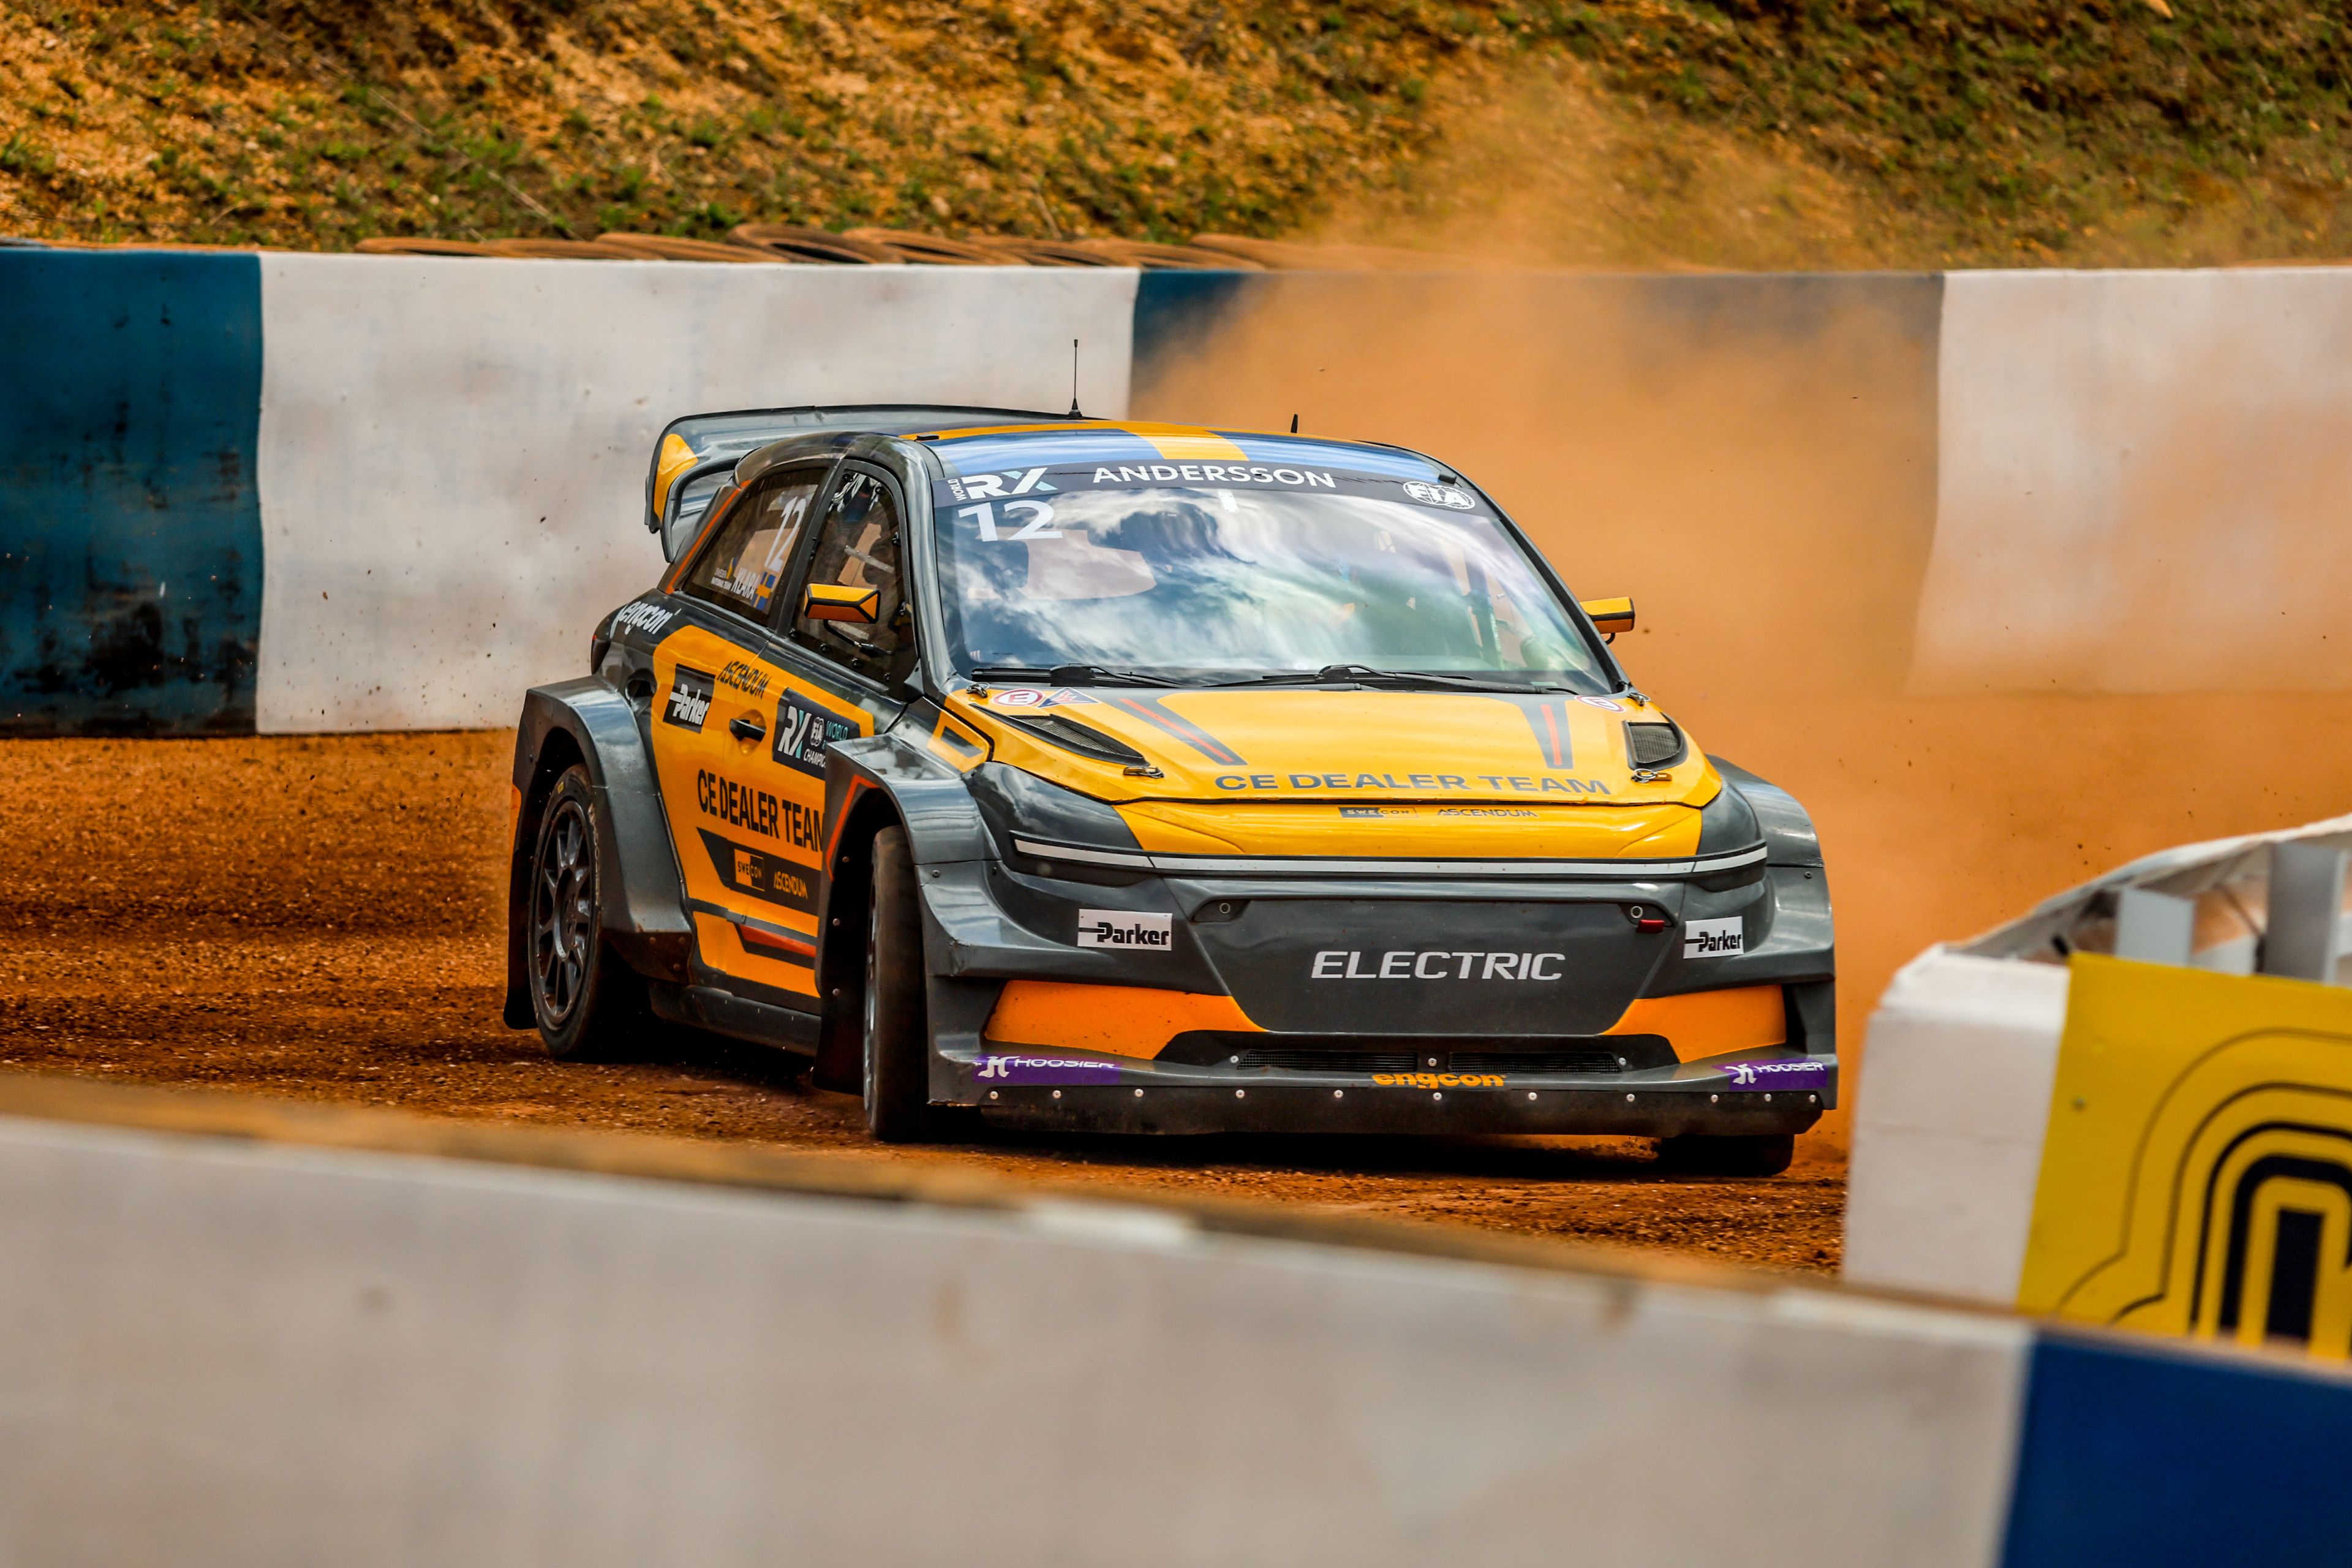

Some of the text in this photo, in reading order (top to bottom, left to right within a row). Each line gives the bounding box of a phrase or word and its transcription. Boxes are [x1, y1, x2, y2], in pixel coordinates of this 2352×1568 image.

[961, 467, 1058, 500] RX
[1093, 466, 1336, 488] ANDERSSON
[948, 479, 967, 501] WORLD
[1407, 484, 1471, 506] FIA
[958, 500, 1063, 542] 12
[764, 496, 807, 573] 12
[619, 601, 673, 635] engcon
[717, 661, 772, 700] ASCENDUM
[669, 684, 710, 725] Parker
[778, 706, 812, 759] RX
[826, 720, 848, 741] WORLD
[804, 748, 826, 768] CHAMPIO
[1214, 774, 1611, 795] CE DEALER TEAM
[698, 769, 717, 816] CE
[720, 777, 780, 839] DEALER
[1437, 808, 1538, 818] ASCENDUM
[774, 871, 808, 900] ASCENDUM
[1097, 922, 1169, 945] Parker
[1698, 930, 1742, 952] Parker
[1311, 951, 1566, 980] ELECTRIC
[1014, 1058, 1115, 1068] HOOSIER
[1753, 1062, 1825, 1073] HOOSIER
[1371, 1072, 1504, 1090] engcon
